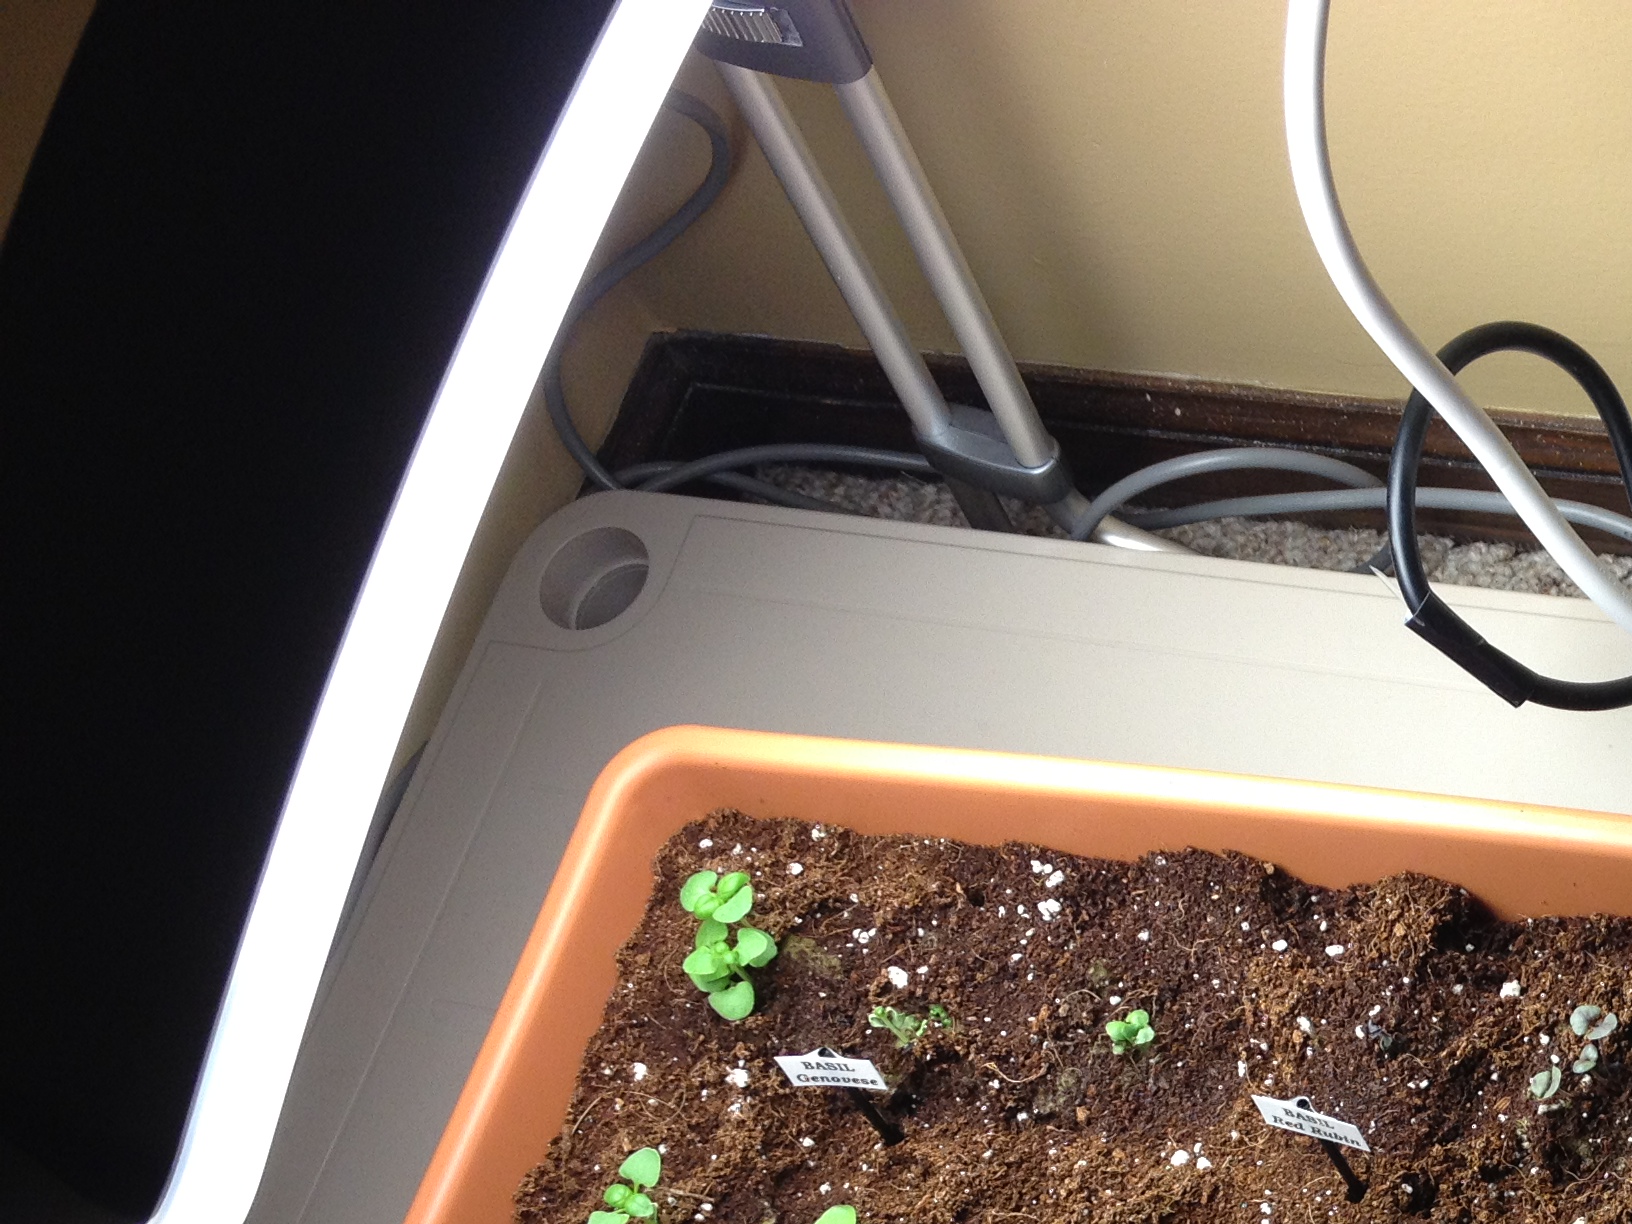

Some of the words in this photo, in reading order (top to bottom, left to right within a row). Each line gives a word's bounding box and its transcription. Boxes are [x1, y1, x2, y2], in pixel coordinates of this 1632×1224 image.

[801, 1061, 855, 1072] BASIL
[796, 1073, 878, 1086] Genovese
[1282, 1107, 1335, 1130] BASIL
[1272, 1115, 1305, 1131] Red
[1311, 1126, 1361, 1147] Rubin
